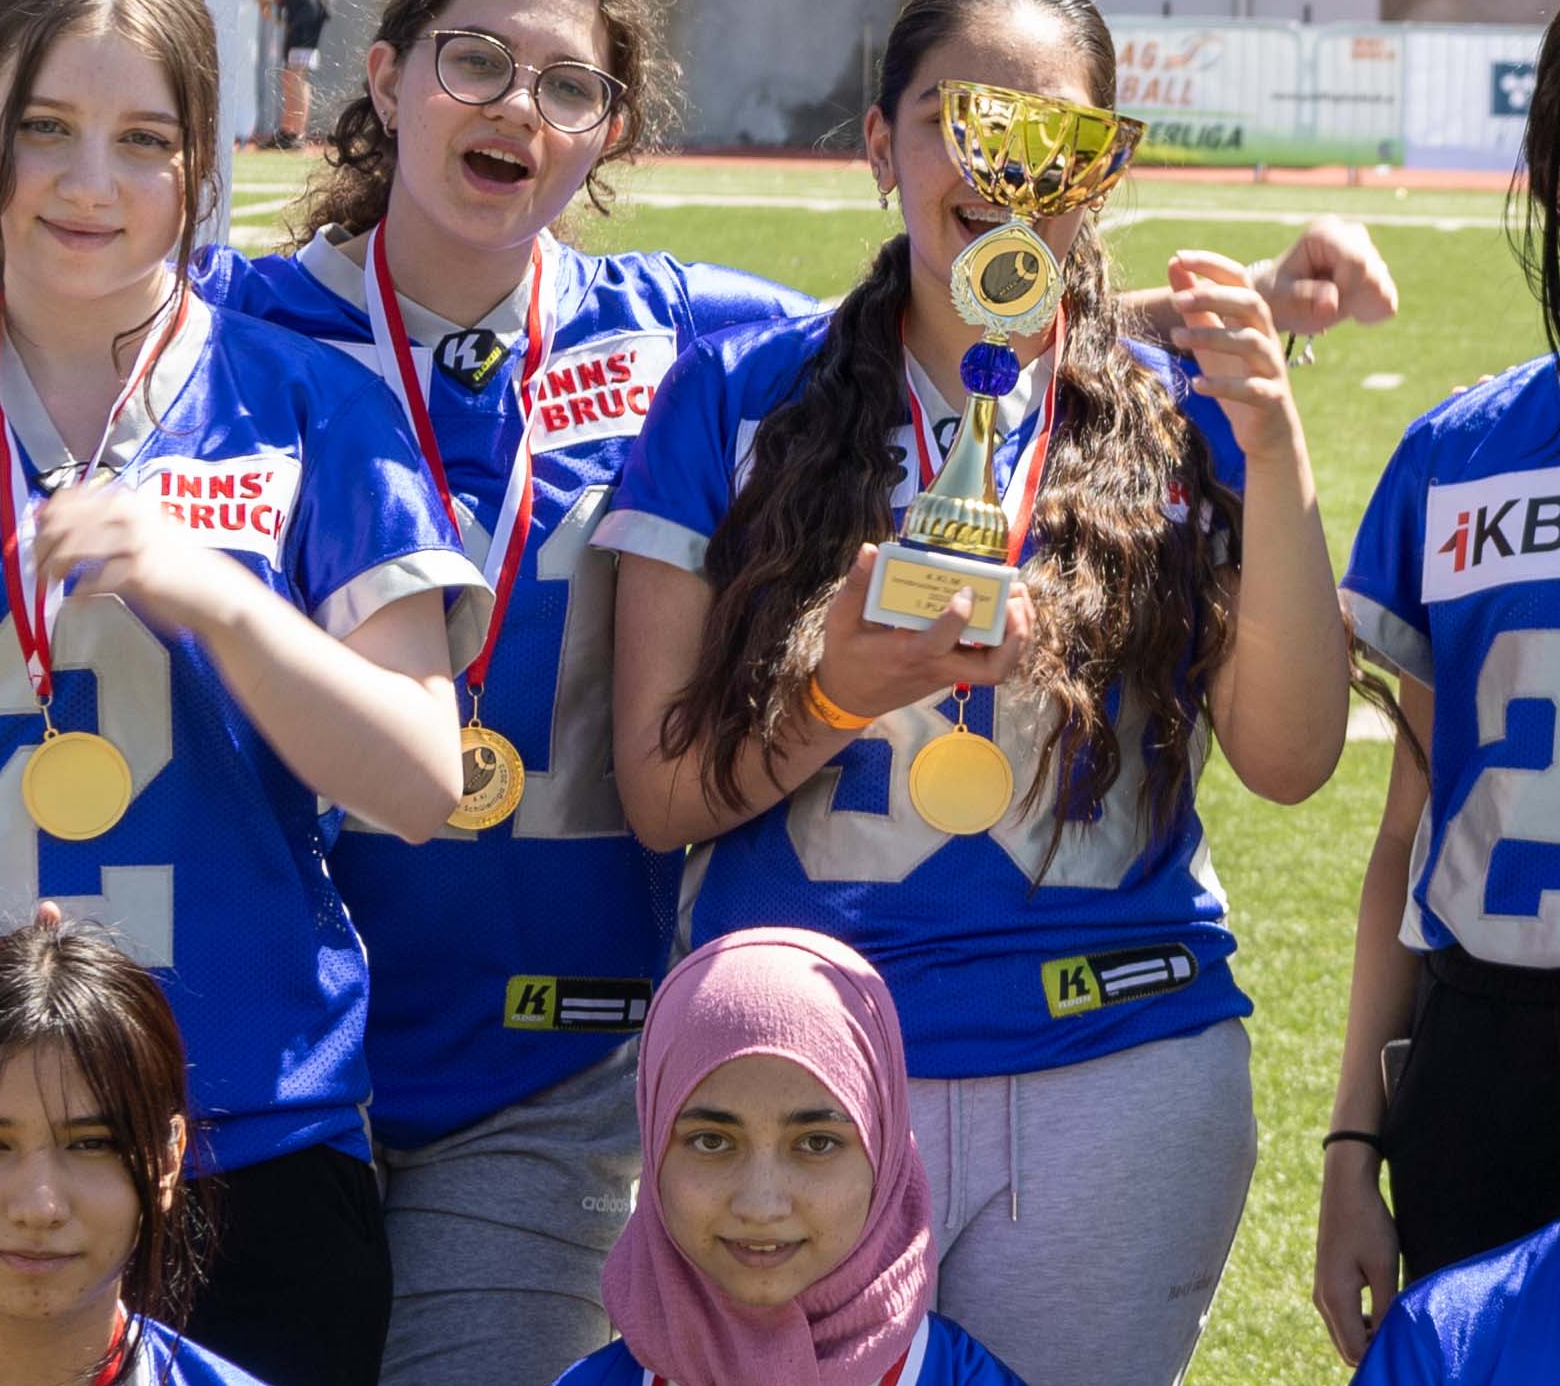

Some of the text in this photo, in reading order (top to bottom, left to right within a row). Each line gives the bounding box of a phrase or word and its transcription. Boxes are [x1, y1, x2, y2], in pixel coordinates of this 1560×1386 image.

[1145, 120, 1245, 151] ERLIGA
[539, 384, 656, 433] BRUC
[159, 470, 274, 501] INNS'
